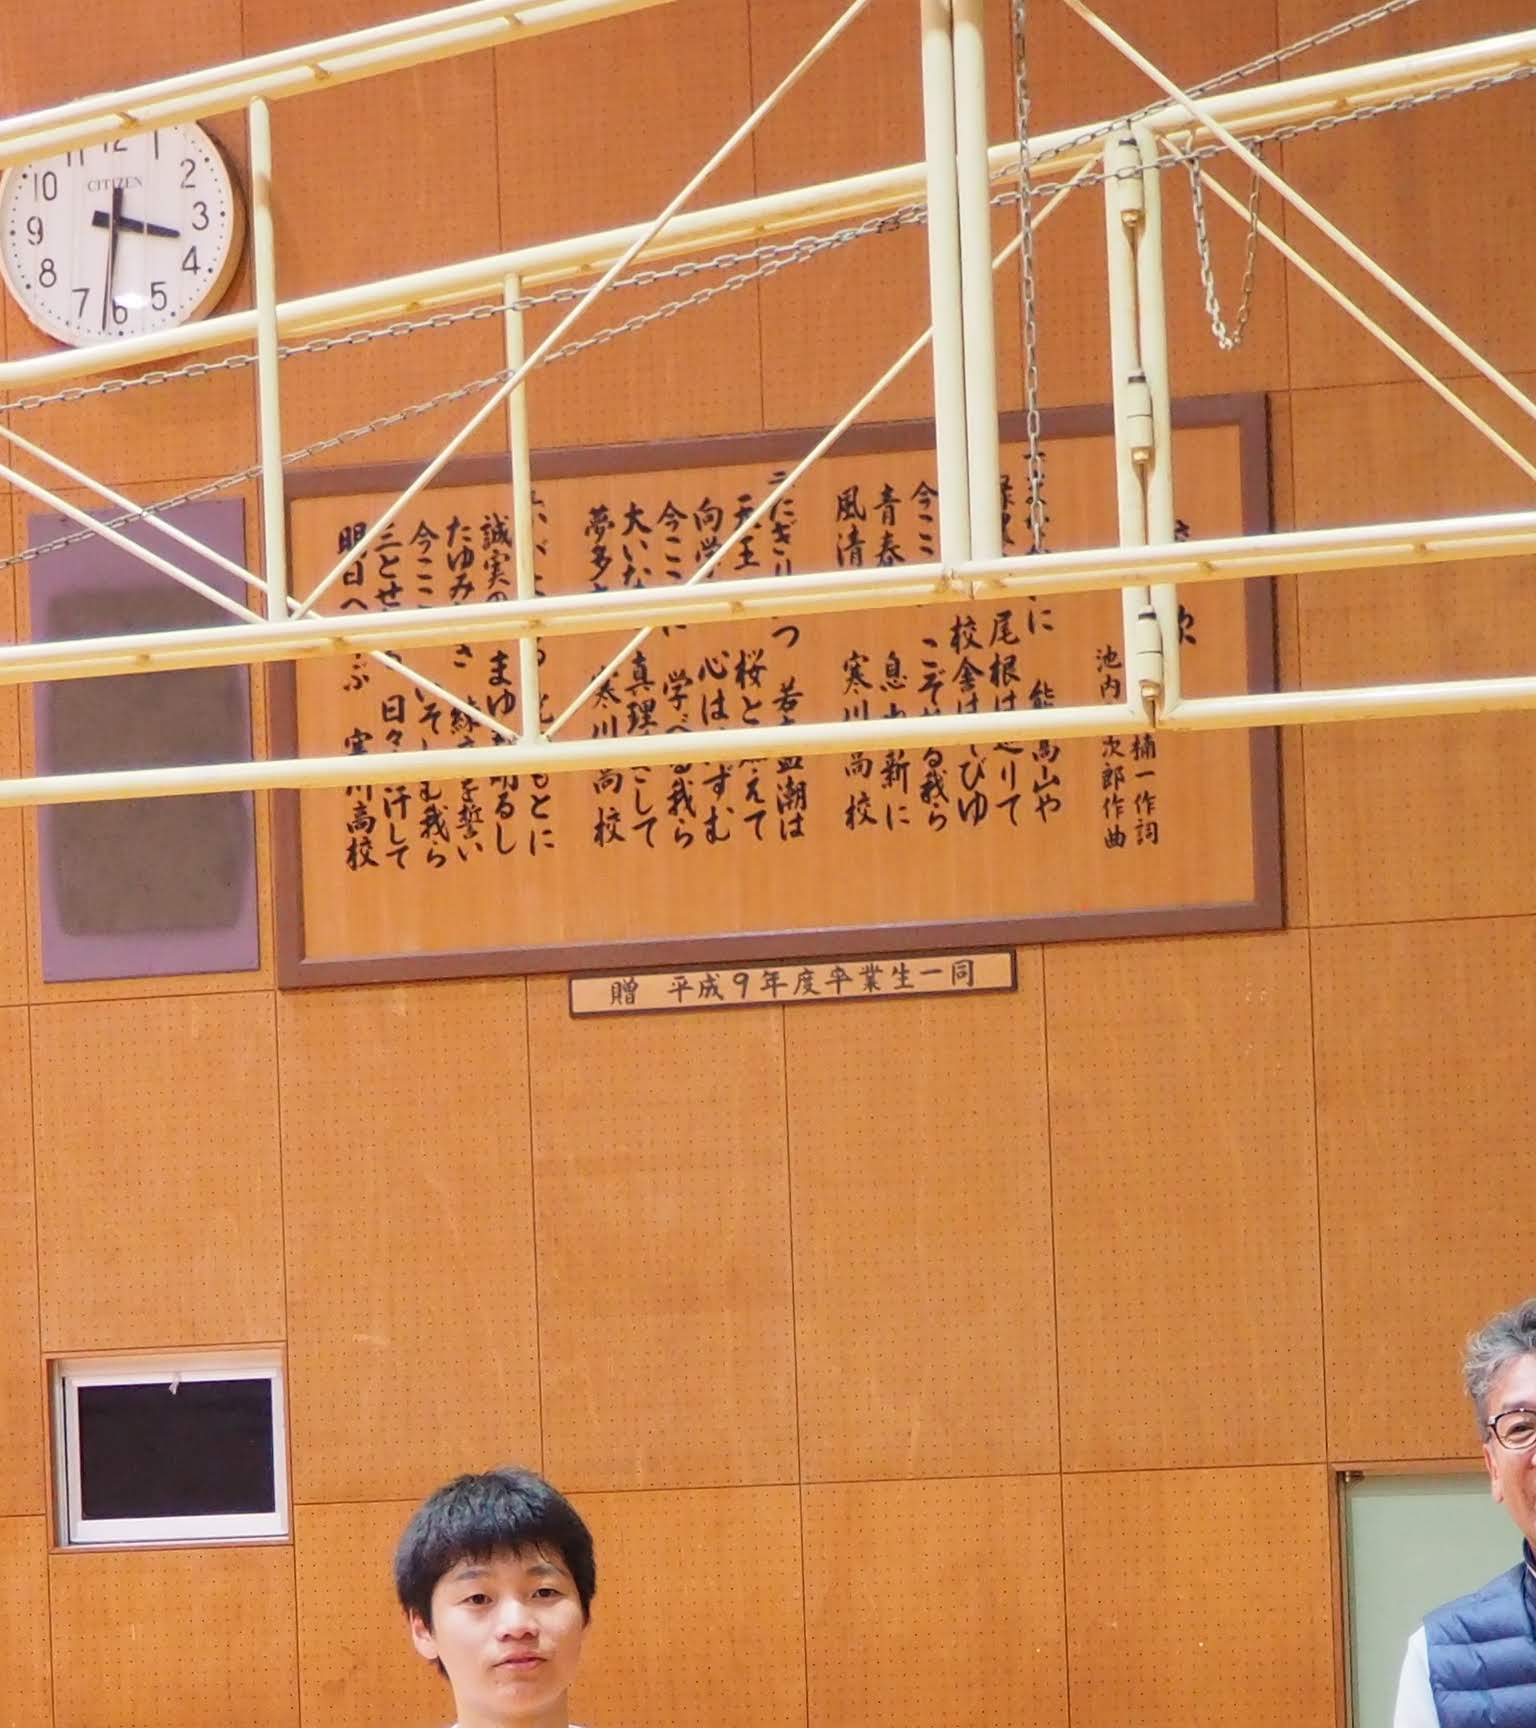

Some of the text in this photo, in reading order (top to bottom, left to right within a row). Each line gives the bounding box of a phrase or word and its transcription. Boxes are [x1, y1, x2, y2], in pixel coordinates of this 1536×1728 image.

[34, 171, 57, 202] 10
[87, 175, 143, 193] CITIZEN
[179, 158, 196, 189] 2
[26, 216, 44, 246] 9
[191, 201, 209, 231] 3
[39, 258, 57, 288] 8
[182, 245, 201, 275] 4
[72, 288, 90, 318] 7
[112, 296, 128, 325] 6
[150, 282, 167, 311] 5
[610, 976, 639, 1006] 贈
